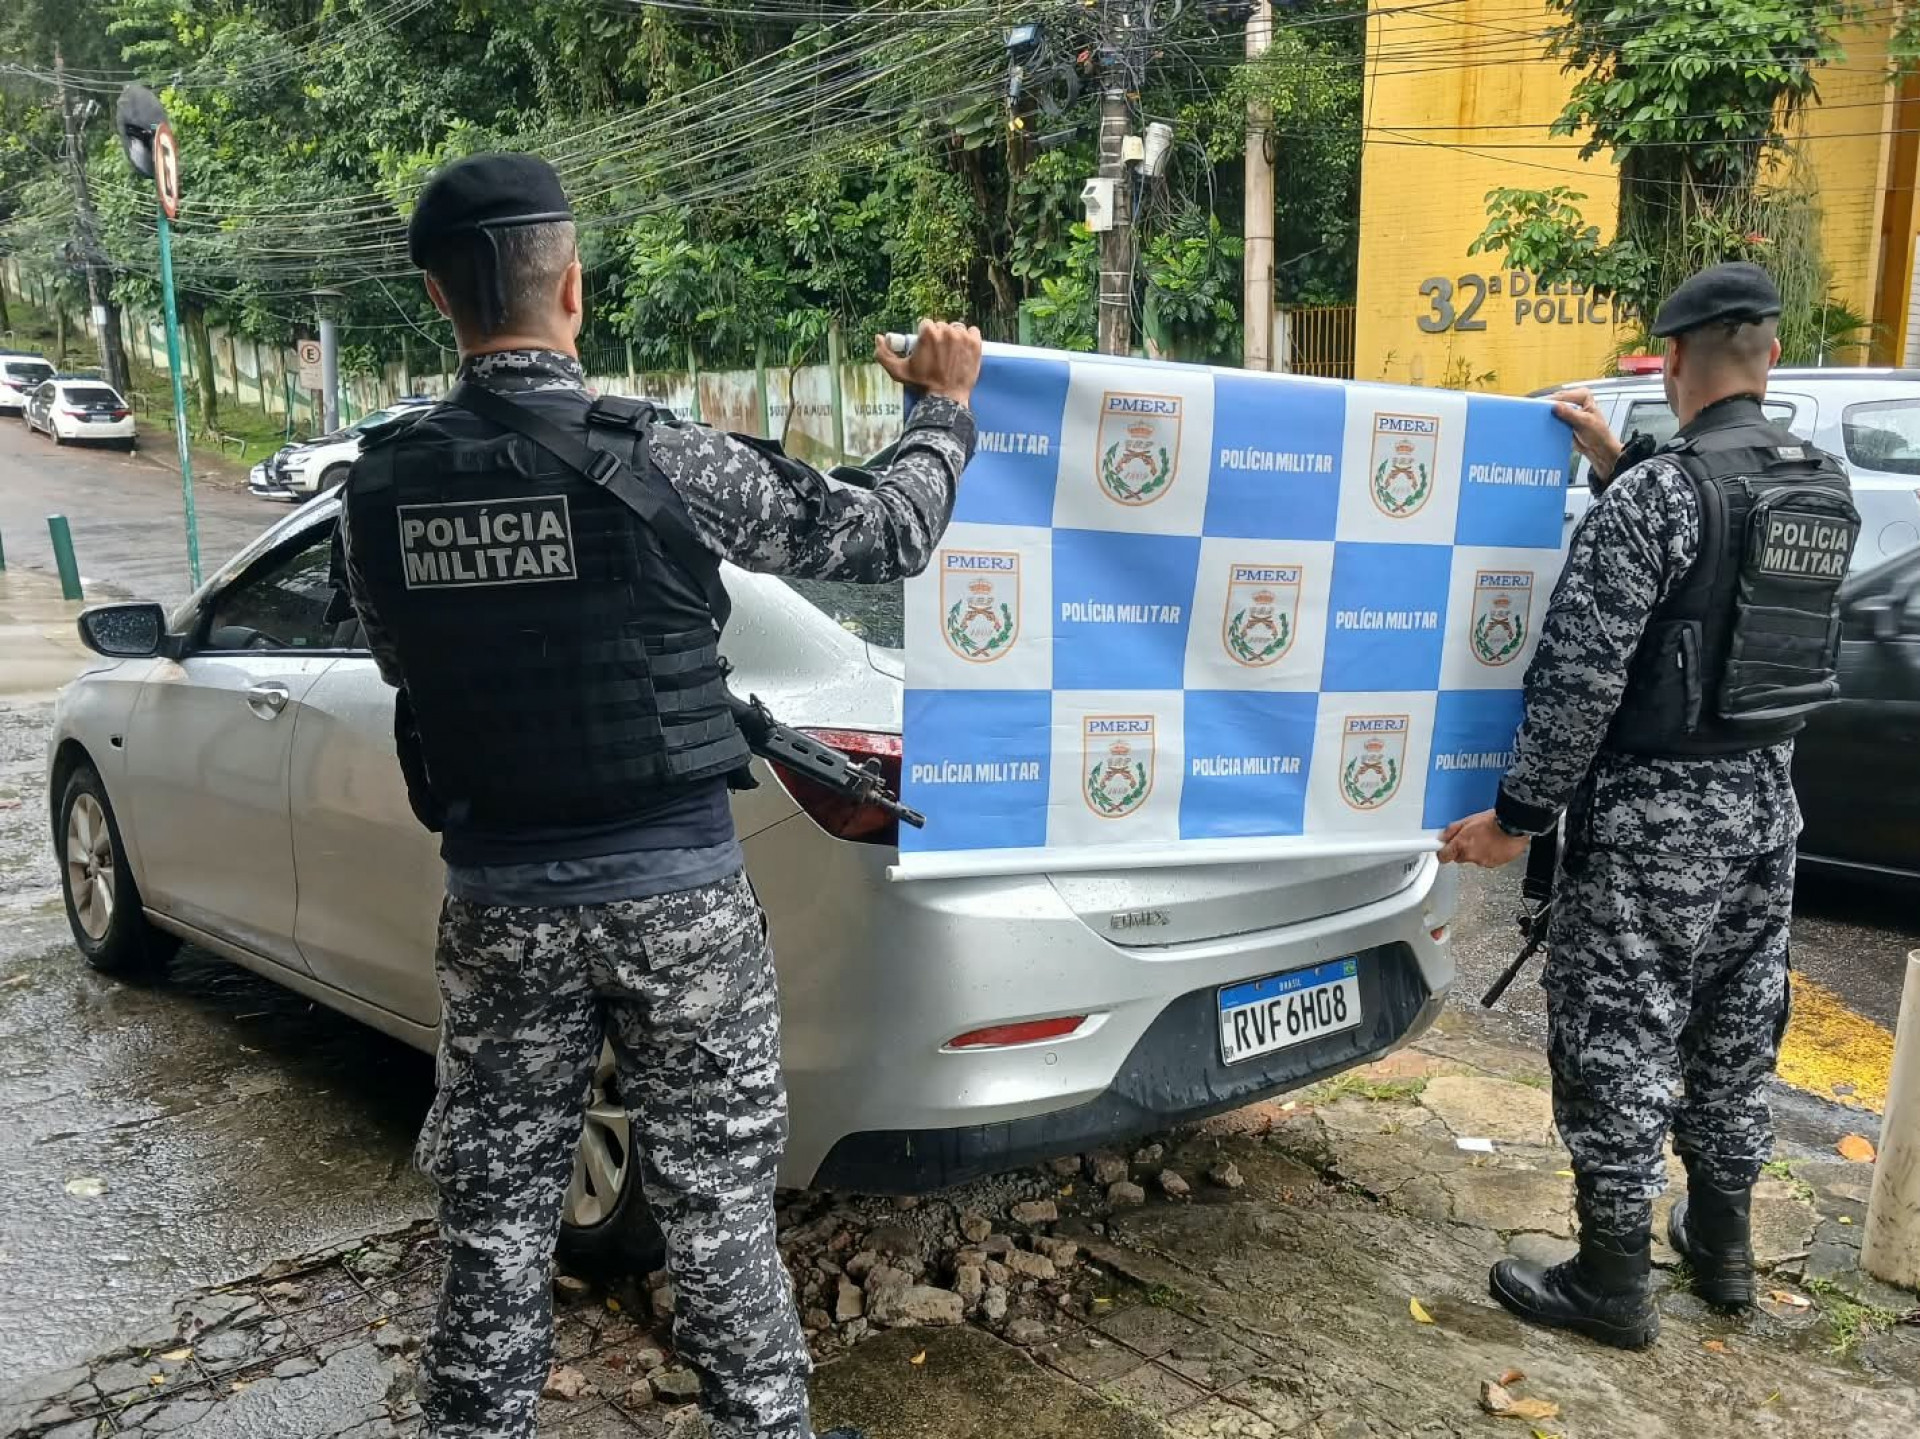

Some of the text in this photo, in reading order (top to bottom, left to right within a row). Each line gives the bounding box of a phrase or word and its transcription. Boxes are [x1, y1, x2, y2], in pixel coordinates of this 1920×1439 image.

[307, 348, 315, 360] E
[1108, 397, 1177, 414] PMERJ
[1378, 418, 1434, 432] PMERJ
[978, 430, 1050, 455] MILITAR
[1220, 446, 1333, 473] POLÍCIA MILITAR
[1469, 462, 1562, 486] POLÍCIA MILITAR
[403, 508, 565, 548] POLÍCIA
[1768, 520, 1849, 551] POLÍCIA
[407, 544, 571, 582] MILITAR
[947, 555, 1014, 570] PMERJ
[1763, 547, 1845, 576] MILITAR
[1236, 569, 1298, 582] PMERJ
[1480, 575, 1529, 586] PMERJ
[1061, 599, 1181, 624] POLÍCIA MILITAR
[1335, 607, 1438, 630] POLÍCIA MILITAR
[1089, 721, 1149, 732] PMERJ
[1350, 719, 1404, 731] PMERJ
[1192, 754, 1300, 776] POLÍCIA MILITAR
[1435, 748, 1479, 771] POLÍCIA
[911, 760, 1040, 783] POLÍCIA MILITAR
[1233, 984, 1347, 1052] RVF6H08
